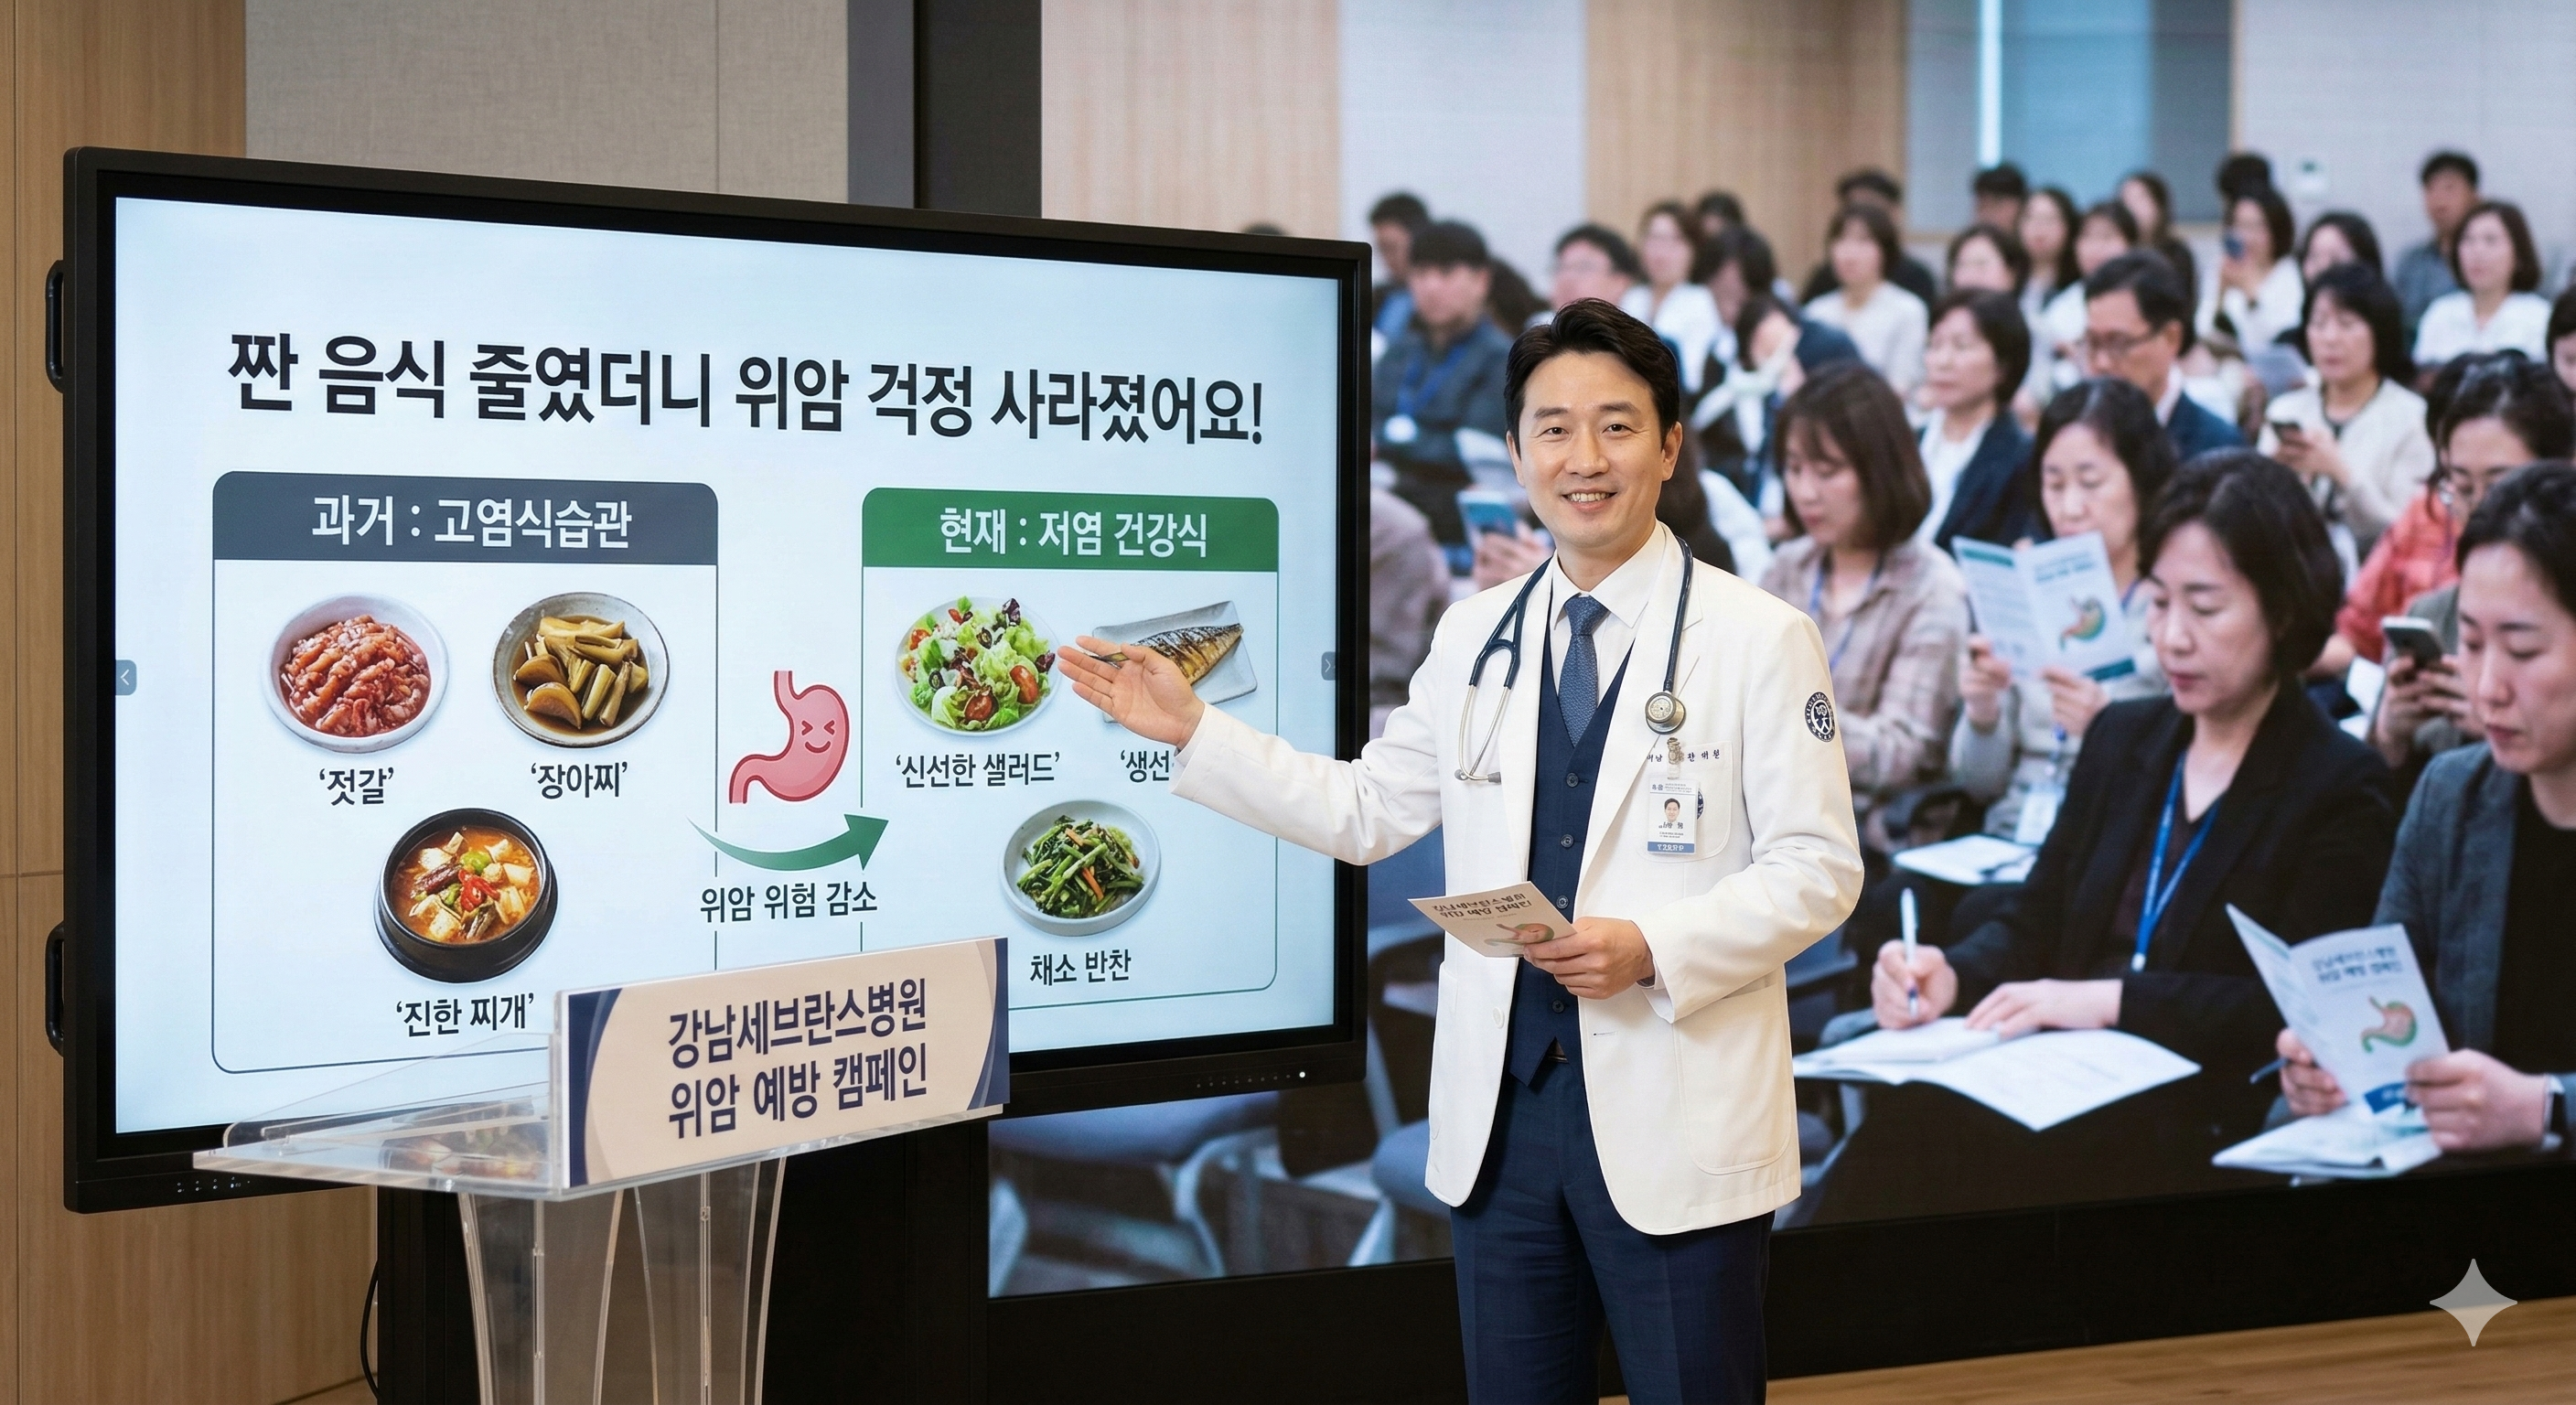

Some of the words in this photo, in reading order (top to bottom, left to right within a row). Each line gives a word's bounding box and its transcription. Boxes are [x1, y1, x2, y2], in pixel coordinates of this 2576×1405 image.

[228, 333, 298, 411] 짠
[319, 336, 444, 418] 음식
[470, 345, 710, 427] 줄였더니
[736, 357, 849, 432] 위암
[868, 364, 971, 437] 걱정
[991, 370, 1261, 445] 사라졌어요!
[313, 495, 392, 545] 과거
[412, 506, 420, 536] :
[435, 499, 631, 548] 고염식습관
[940, 508, 1005, 553] 현재
[1020, 519, 1026, 545] :
[1038, 511, 1100, 555] 저염
[1114, 513, 1206, 557] 건강식
[320, 767, 393, 806] ‘젓갈’
[531, 762, 627, 799] ‘장아찌’
[896, 755, 976, 788] ‘신선한
[1121, 750, 1175, 783] ‘생선
[701, 886, 755, 922] 위암
[765, 883, 814, 919] 위험
[826, 881, 878, 915] 감소
[1030, 954, 1077, 986] 채소
[1086, 949, 1131, 982] 반찬
[397, 999, 462, 1036] ‘진한
[470, 993, 533, 1030] 찌개’
[669, 978, 926, 1068] 강남세브란스병원
[669, 1074, 739, 1139] 위암
[755, 1060, 820, 1121] 예방
[833, 1043, 927, 1110] 캠페인
